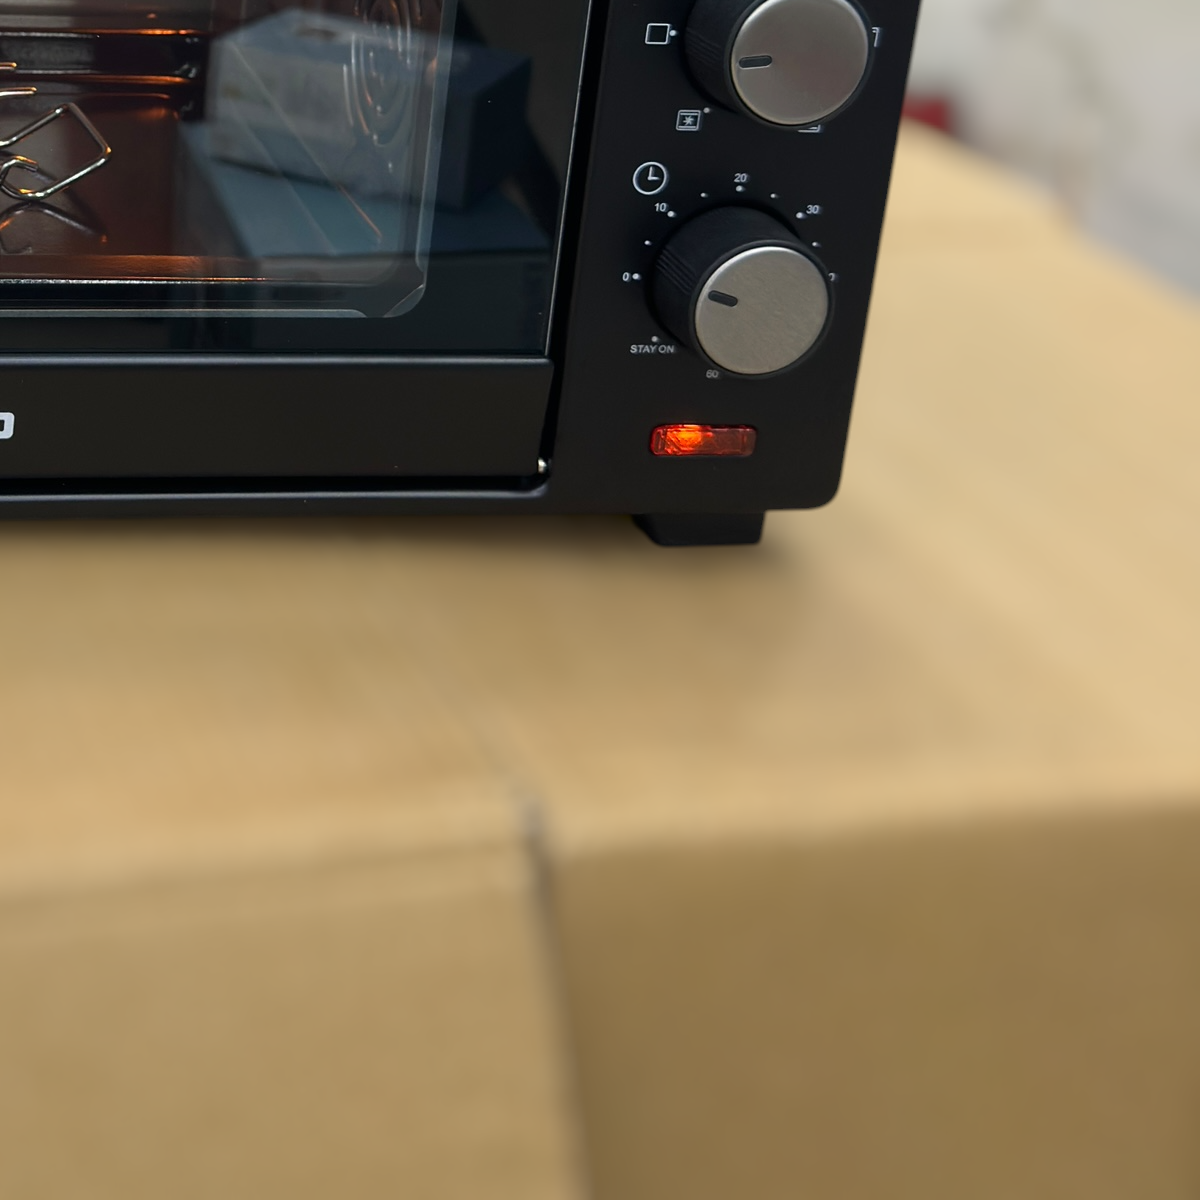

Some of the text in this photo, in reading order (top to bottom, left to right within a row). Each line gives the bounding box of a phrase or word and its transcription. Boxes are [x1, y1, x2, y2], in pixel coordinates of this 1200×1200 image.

[734, 173, 747, 183] 20
[654, 202, 667, 212] 10
[806, 204, 819, 215] 30
[622, 272, 629, 282] 0
[630, 344, 674, 354] STAY ON
[706, 369, 719, 379] 60
